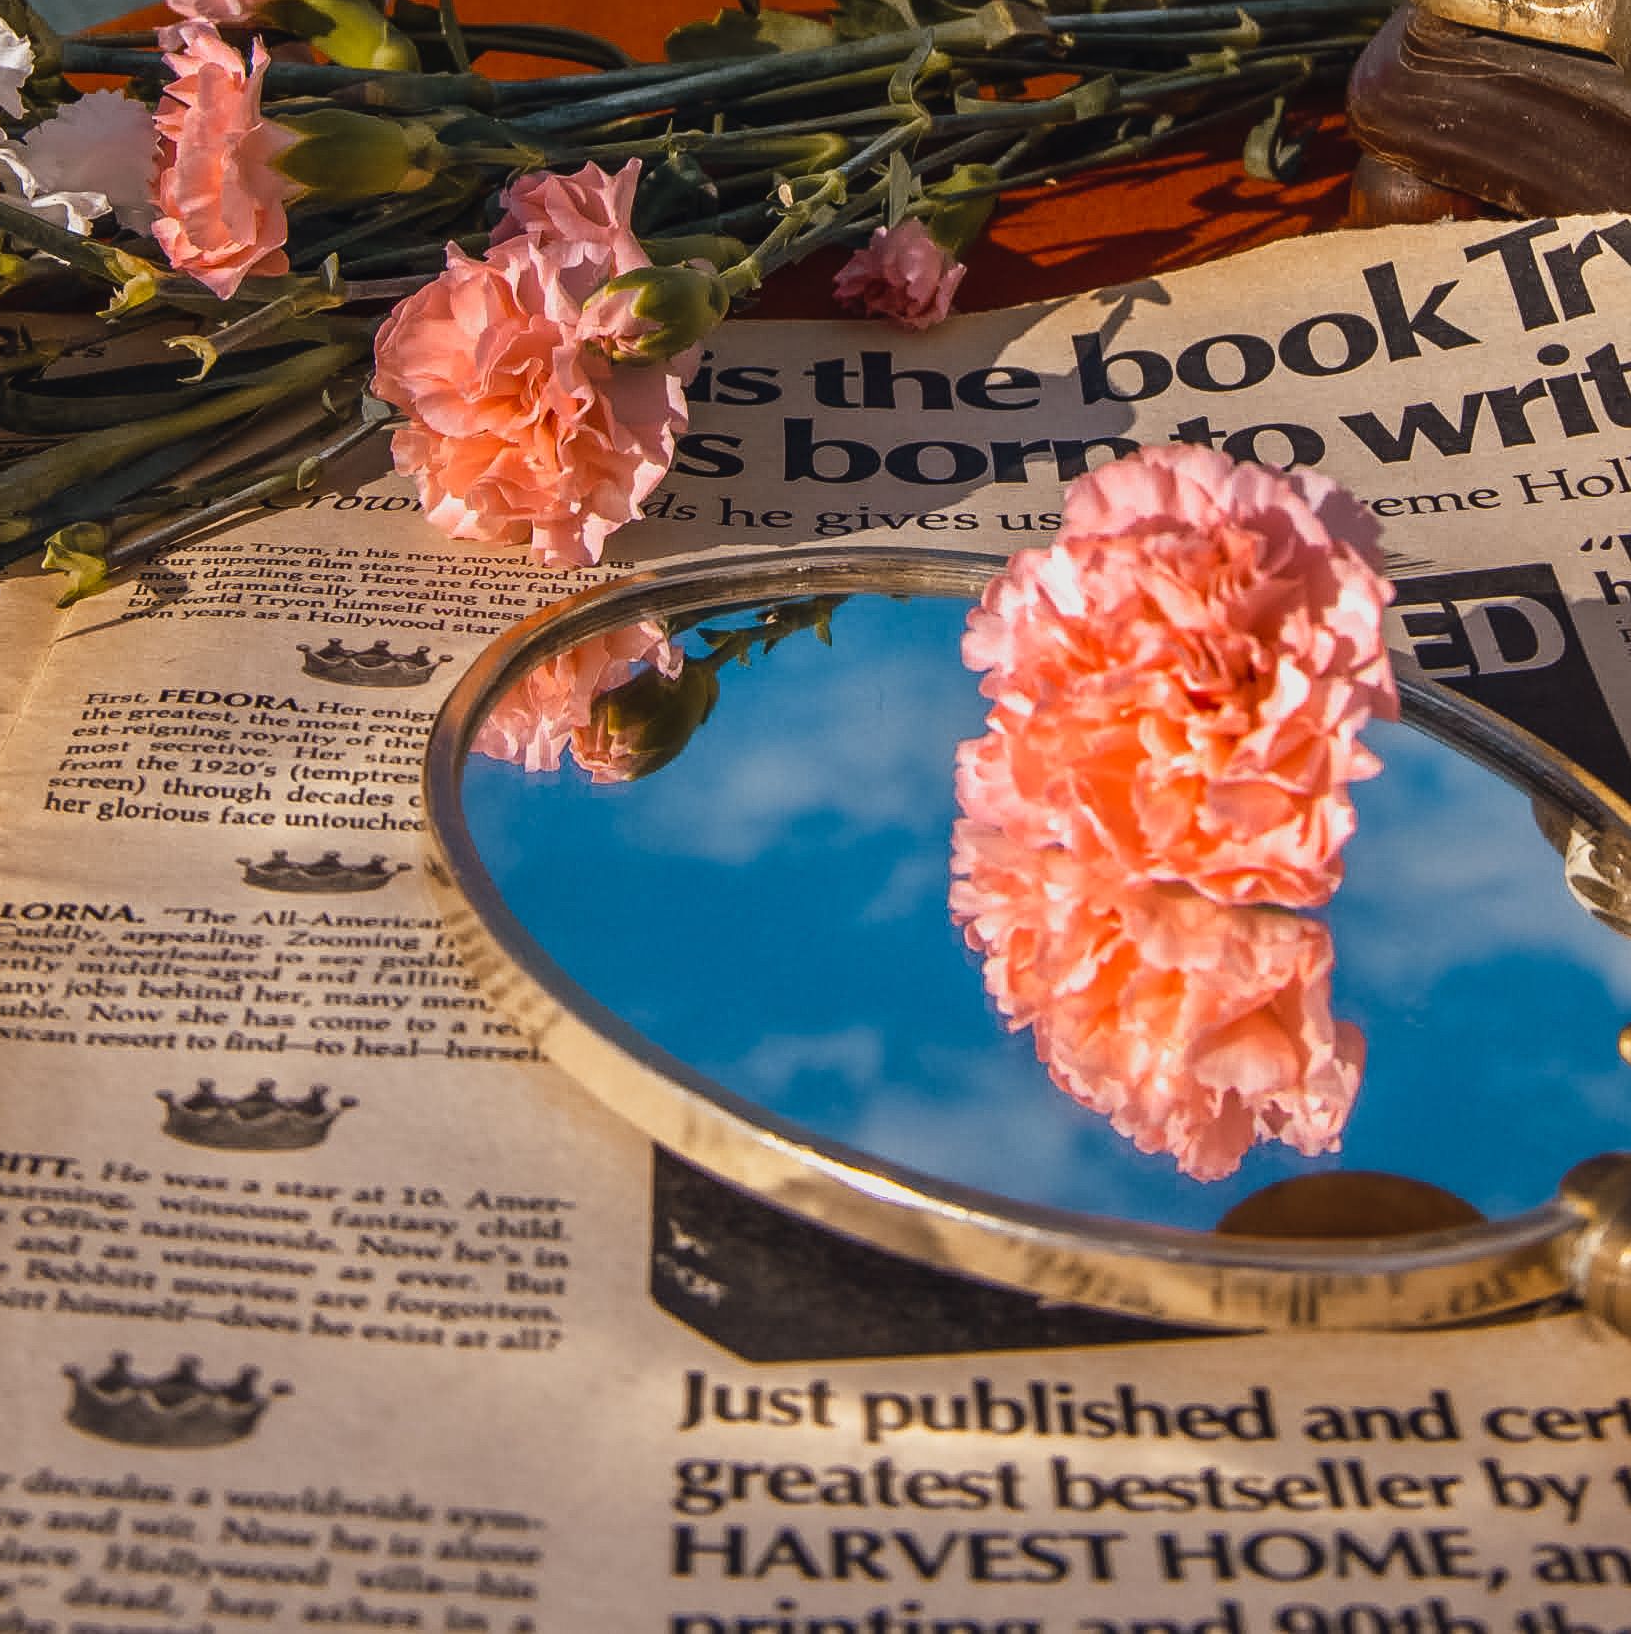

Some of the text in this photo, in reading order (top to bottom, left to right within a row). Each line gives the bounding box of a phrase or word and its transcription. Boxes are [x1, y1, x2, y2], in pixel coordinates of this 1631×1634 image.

[806, 352, 1041, 410] the
[1071, 261, 1482, 407] book
[782, 417, 1143, 485] born
[1169, 413, 1327, 474] to
[720, 499, 793, 528] he
[816, 505, 979, 536] gives
[999, 512, 1062, 532] us
[159, 689, 308, 713] FEDORA.
[316, 701, 367, 717] Her
[44, 791, 276, 825] her glorious face
[48, 774, 395, 807] screen) through decades
[0, 902, 146, 924] LORNA.
[680, 1371, 835, 1431] Just
[861, 1378, 1277, 1444] published
[1302, 1389, 1460, 1443] and
[674, 1458, 1025, 1516] greatest
[1051, 1455, 1461, 1512] bestseller
[1477, 1460, 1593, 1524] by
[672, 1524, 1127, 1585] HARVEST
[1156, 1529, 1510, 1594] HOME,
